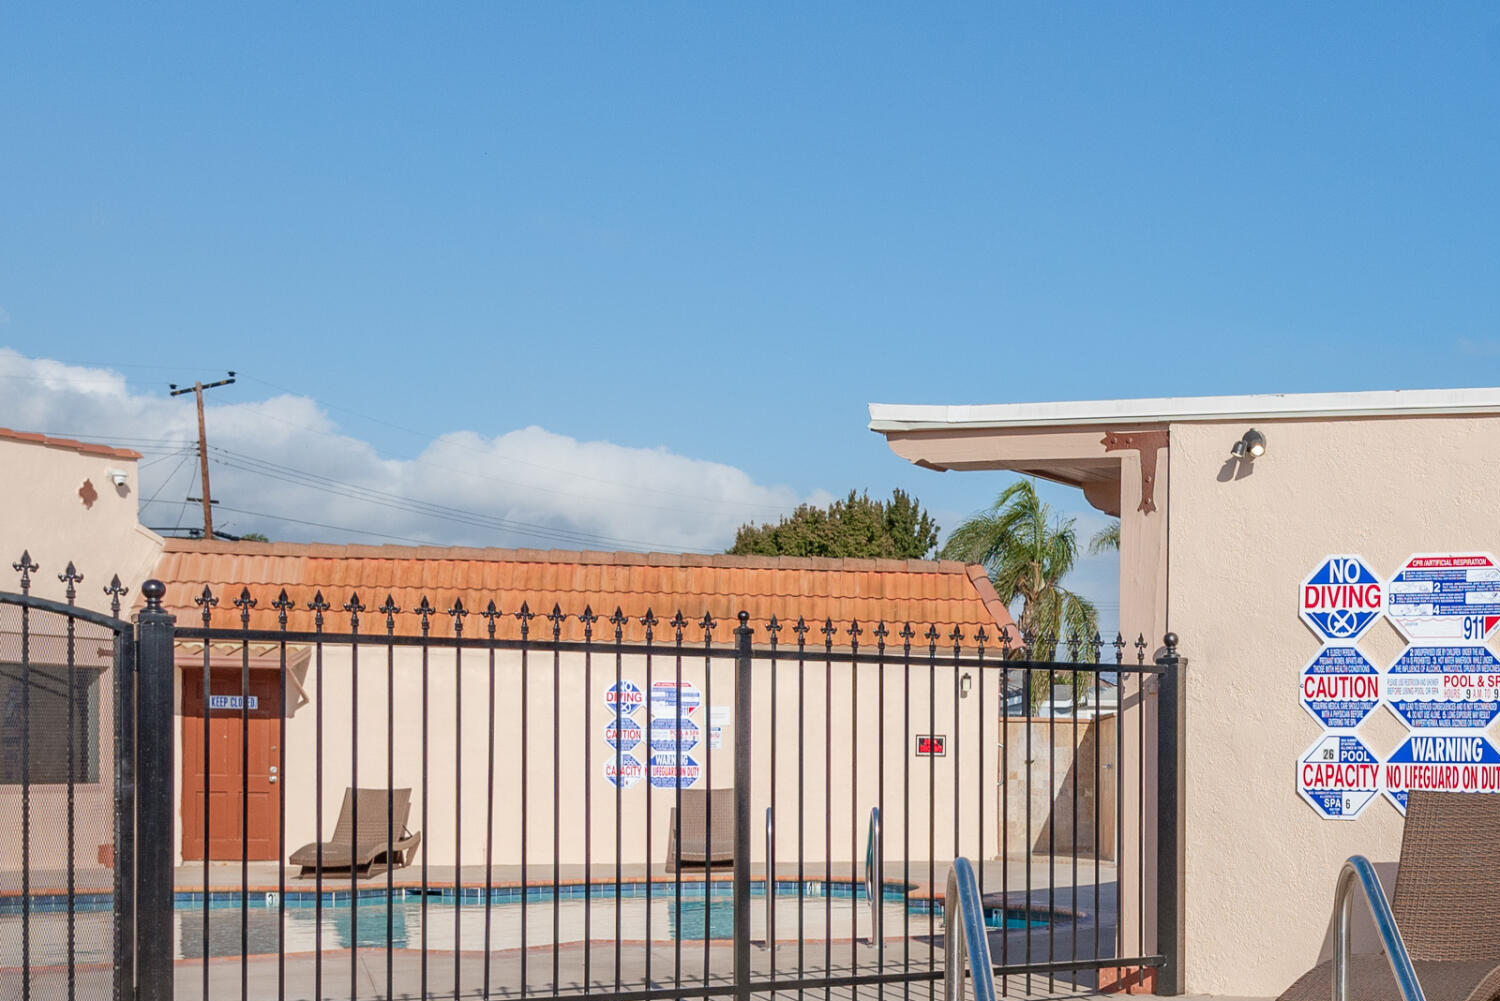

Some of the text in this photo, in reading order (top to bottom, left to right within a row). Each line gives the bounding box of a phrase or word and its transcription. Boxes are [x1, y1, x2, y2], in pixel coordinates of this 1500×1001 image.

[1329, 560, 1360, 583] NO
[1401, 571, 1406, 580] 1
[1433, 583, 1441, 592] 2
[1305, 586, 1381, 608] DIVING
[1389, 595, 1395, 604] 3
[1433, 605, 1440, 615] 4
[1464, 616, 1484, 639] 911
[1444, 676, 1474, 687] POOL
[1477, 676, 1484, 687] &
[1304, 676, 1378, 698] CAUTION
[1466, 689, 1471, 699] 9
[1494, 689, 1499, 699] 9
[211, 696, 255, 707] KEEP CLOED
[606, 729, 641, 739] CATION
[1323, 749, 1334, 760] 26
[1411, 738, 1483, 762] WARNING
[656, 755, 688, 765] WARNG
[1341, 751, 1370, 761] POOL
[606, 766, 641, 776] CAACITY
[1303, 764, 1379, 787] CAPACITY
[1386, 765, 1401, 788] NO
[1405, 765, 1459, 789] LIFEGUARD
[1463, 766, 1477, 789] ON
[1324, 799, 1341, 808] SPA
[1346, 799, 1350, 809] 6
